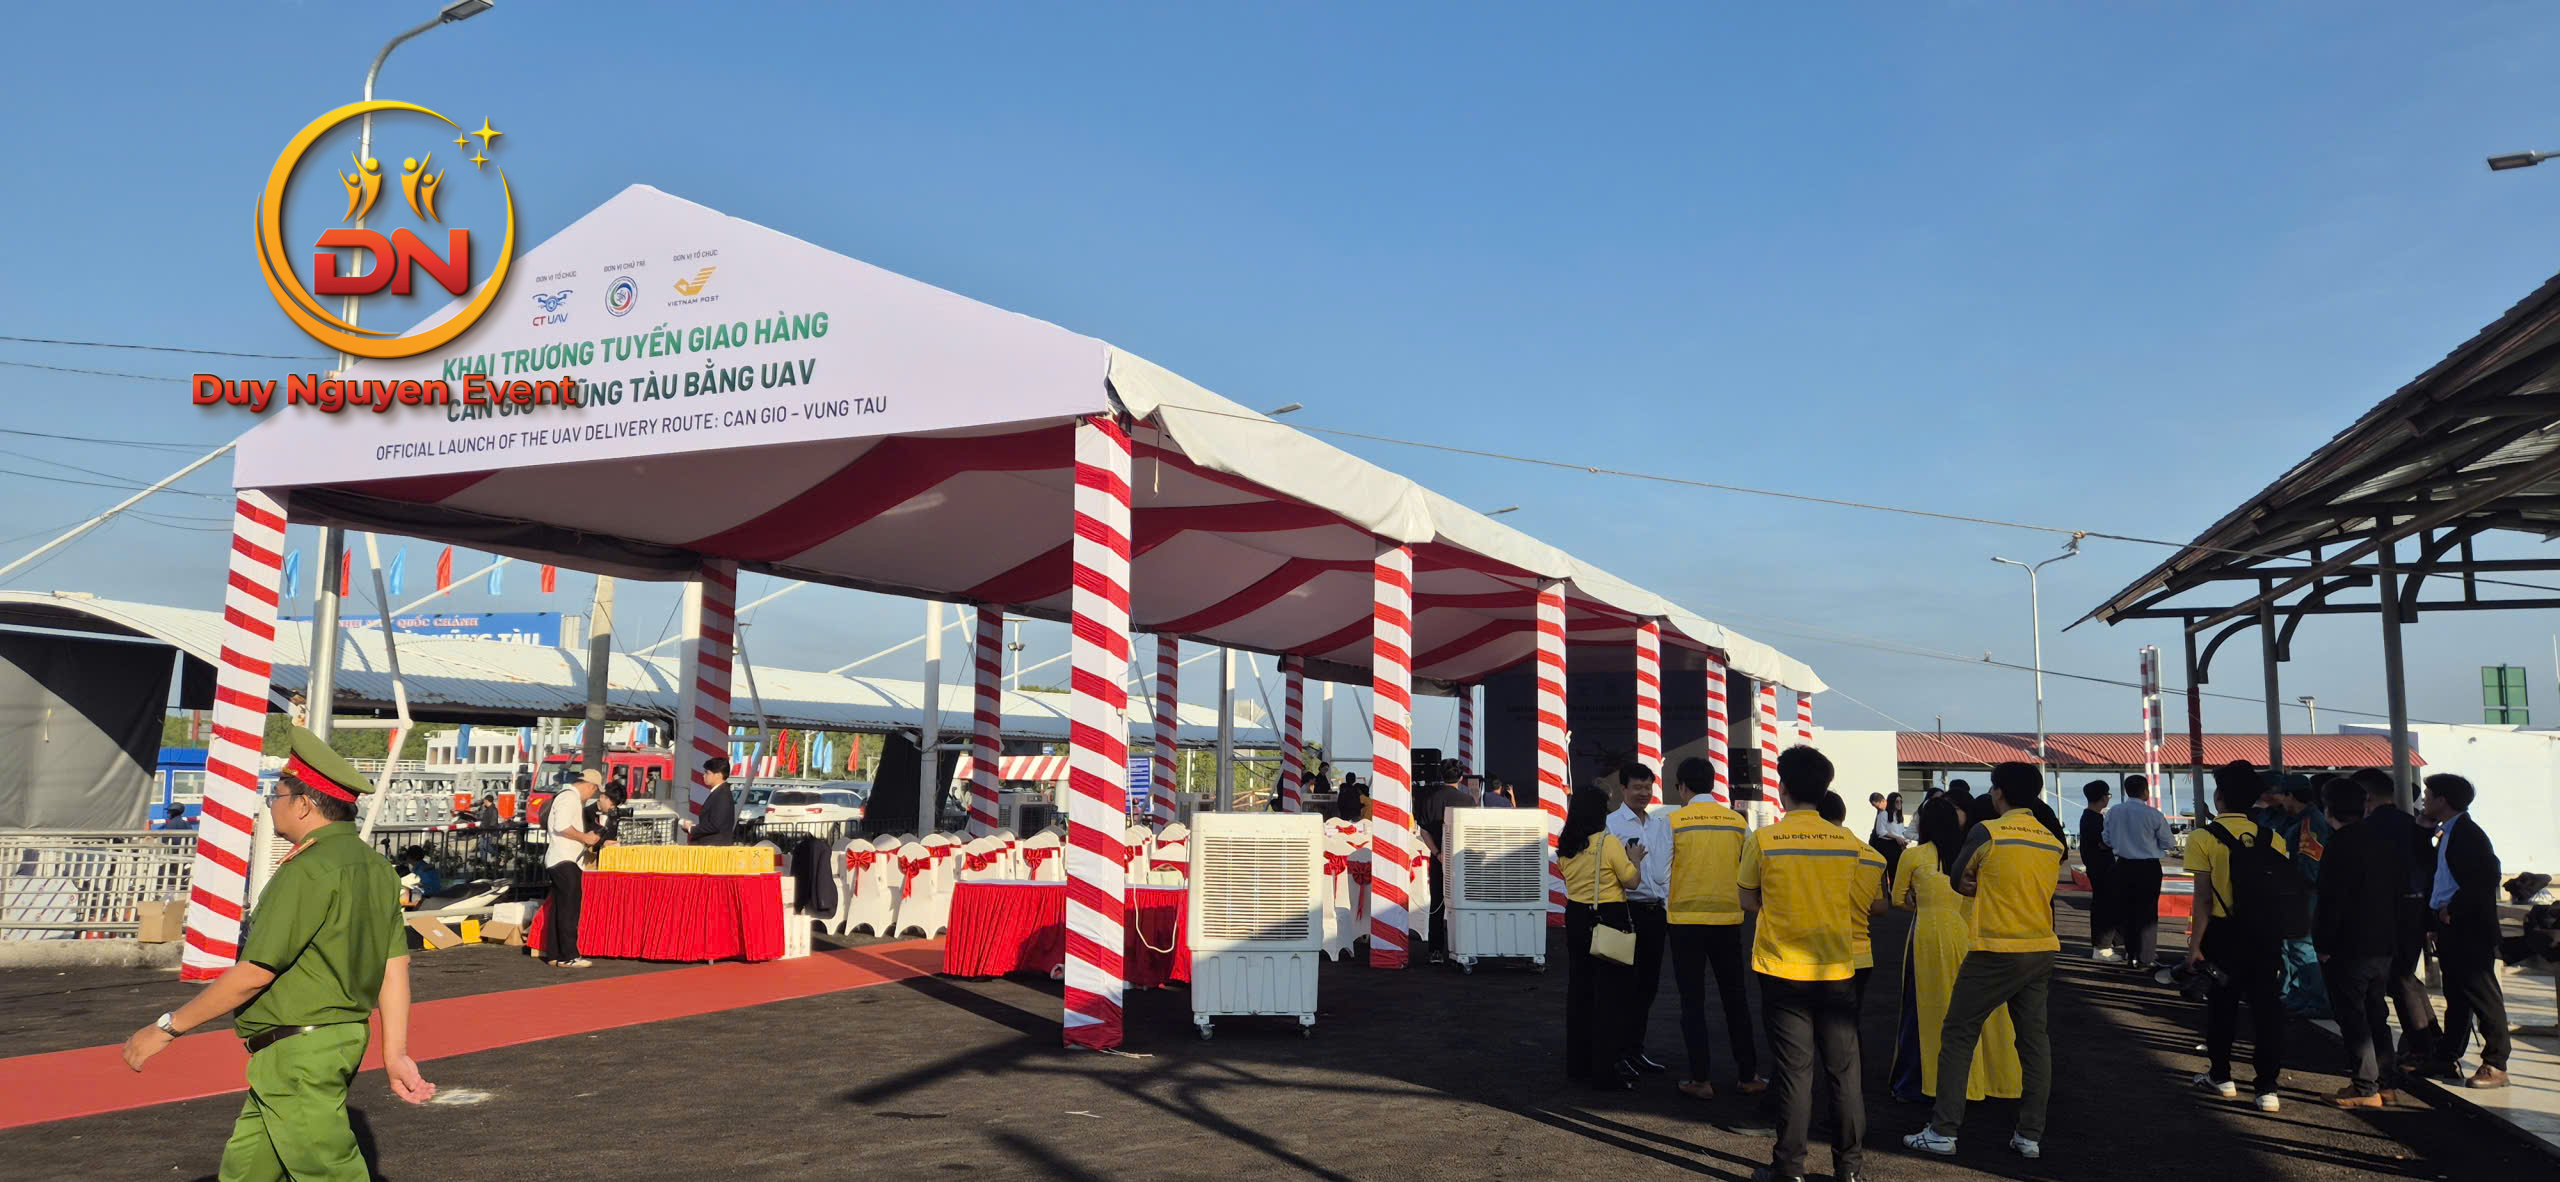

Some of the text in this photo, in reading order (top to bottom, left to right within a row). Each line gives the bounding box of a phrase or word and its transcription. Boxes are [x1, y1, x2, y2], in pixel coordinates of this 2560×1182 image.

[532, 313, 568, 327] CT UAV
[667, 295, 719, 307] VIETNAM POST
[442, 310, 829, 381] KHAI TRƯƠNG TUYẾN GIAO HÀNG
[629, 370, 677, 403] TÀU
[683, 358, 754, 397] BẰNG
[760, 358, 816, 389] UAV
[376, 442, 435, 461] OFFICIAL
[438, 435, 495, 455] LAUNCH
[498, 433, 517, 450] OF
[521, 430, 549, 447] THE
[552, 426, 581, 444] UAV
[585, 418, 658, 441] DELIVERY
[662, 413, 718, 433] ROUTE:
[723, 409, 756, 427] CAN
[761, 405, 787, 424] GIO
[804, 400, 849, 420] VUNG
[854, 395, 887, 415] TAU
